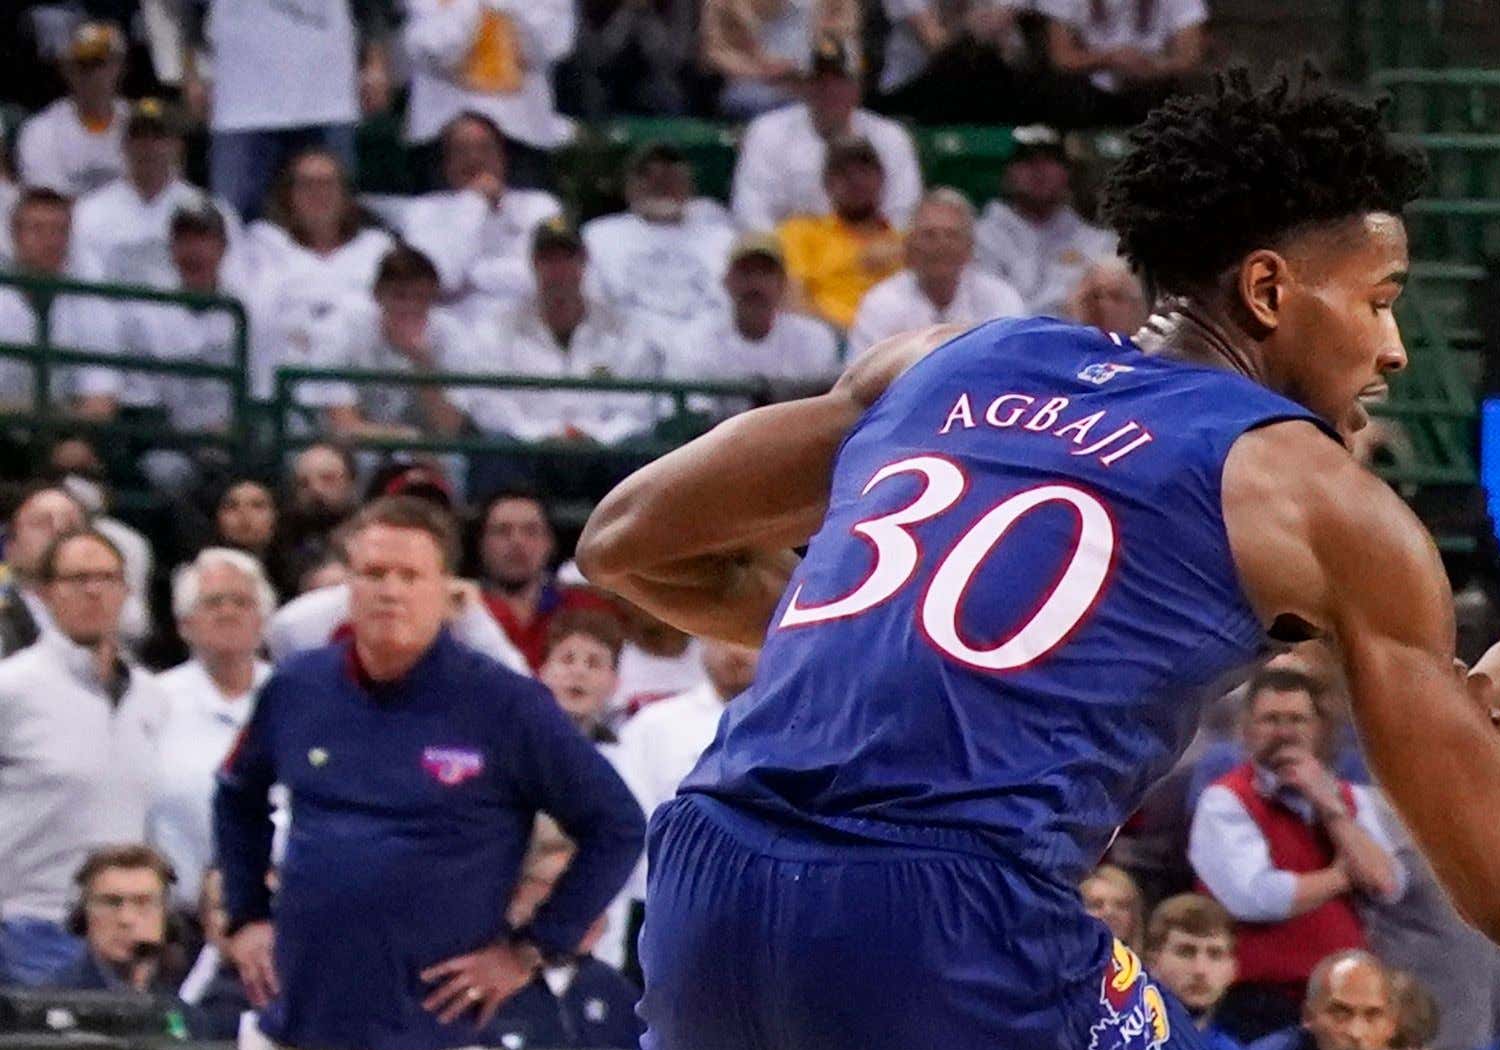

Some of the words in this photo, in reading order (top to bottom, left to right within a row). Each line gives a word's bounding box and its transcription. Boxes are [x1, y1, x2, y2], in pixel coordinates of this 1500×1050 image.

[938, 392, 1154, 468] AGBAJI
[777, 453, 1121, 675] 30
[1119, 1004, 1145, 1044] KU
